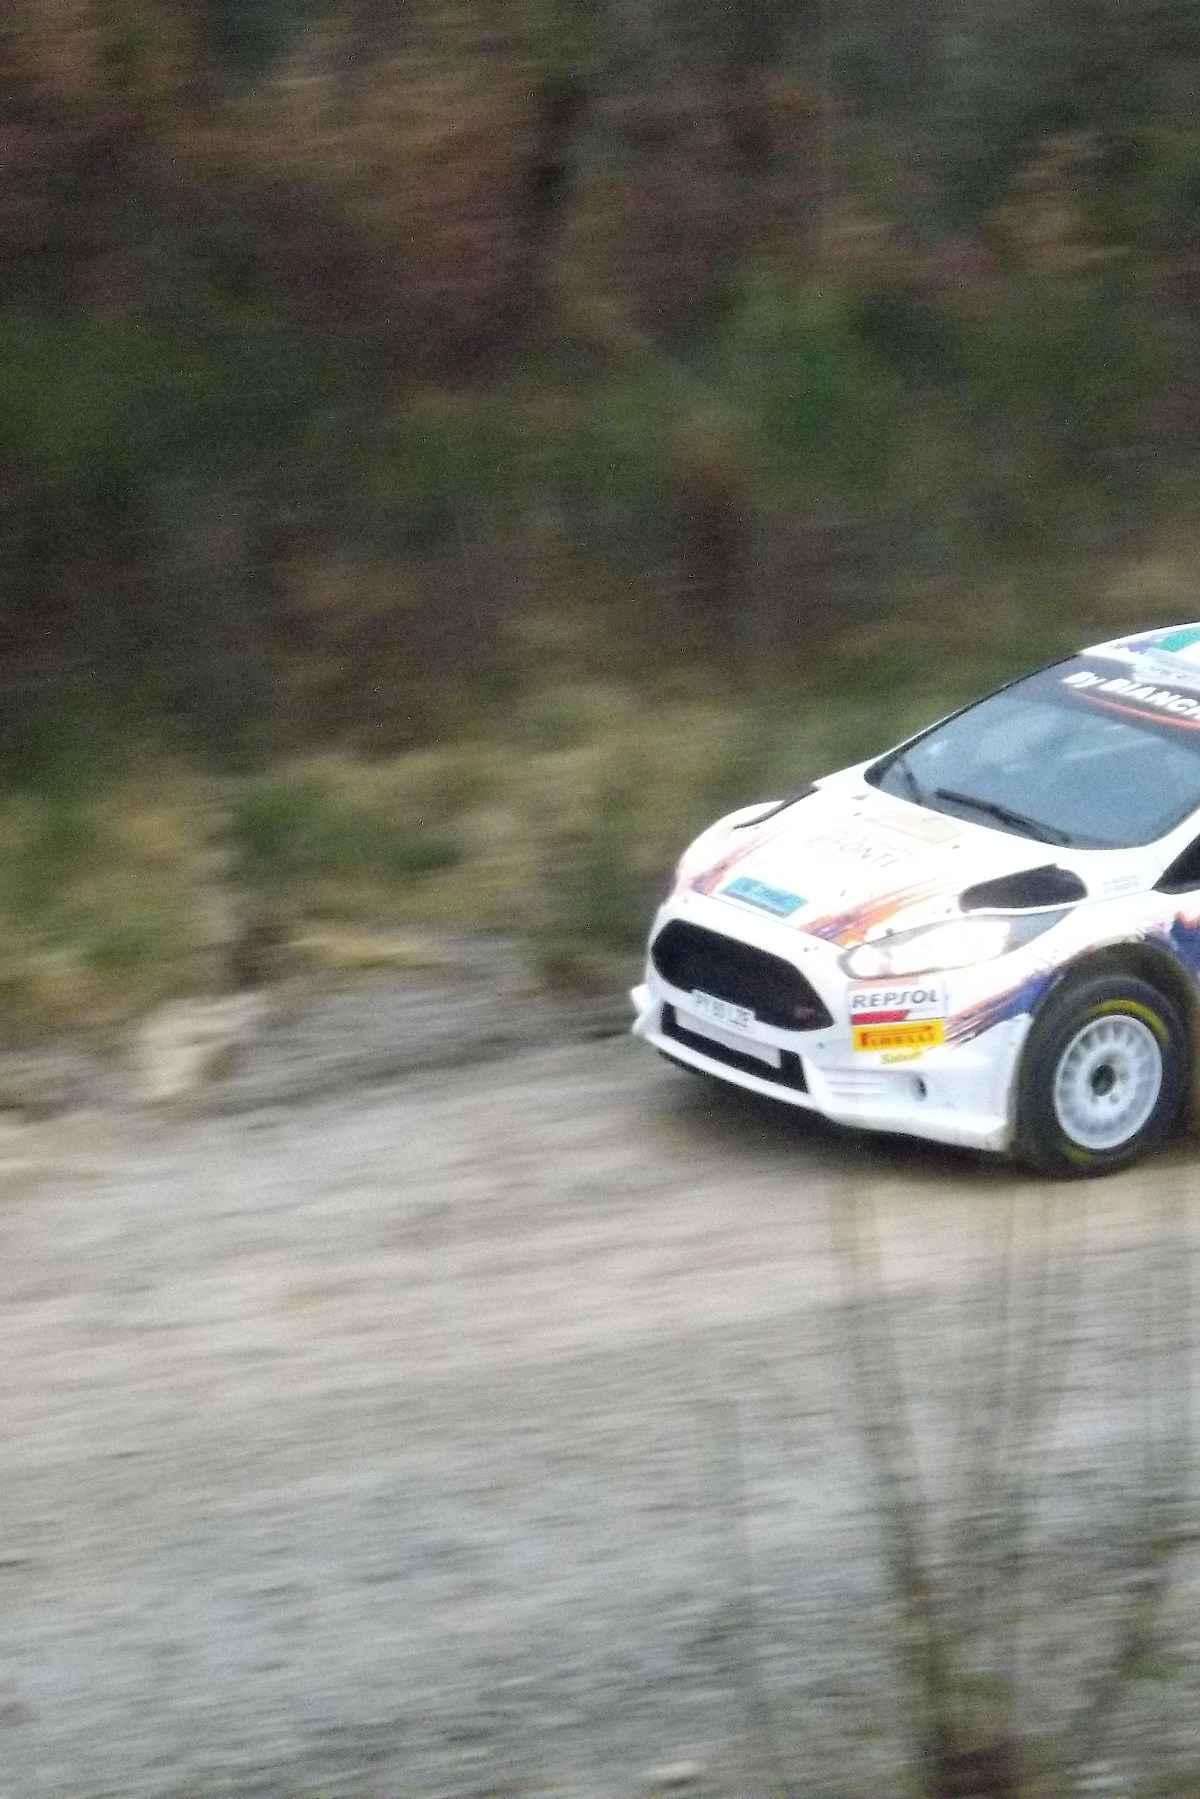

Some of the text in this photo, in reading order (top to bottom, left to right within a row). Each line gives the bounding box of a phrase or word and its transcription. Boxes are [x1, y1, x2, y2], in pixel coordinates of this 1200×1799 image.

[1063, 670, 1107, 689] By
[852, 988, 939, 1009] REPSOL
[858, 1023, 936, 1049] PIRELLI
